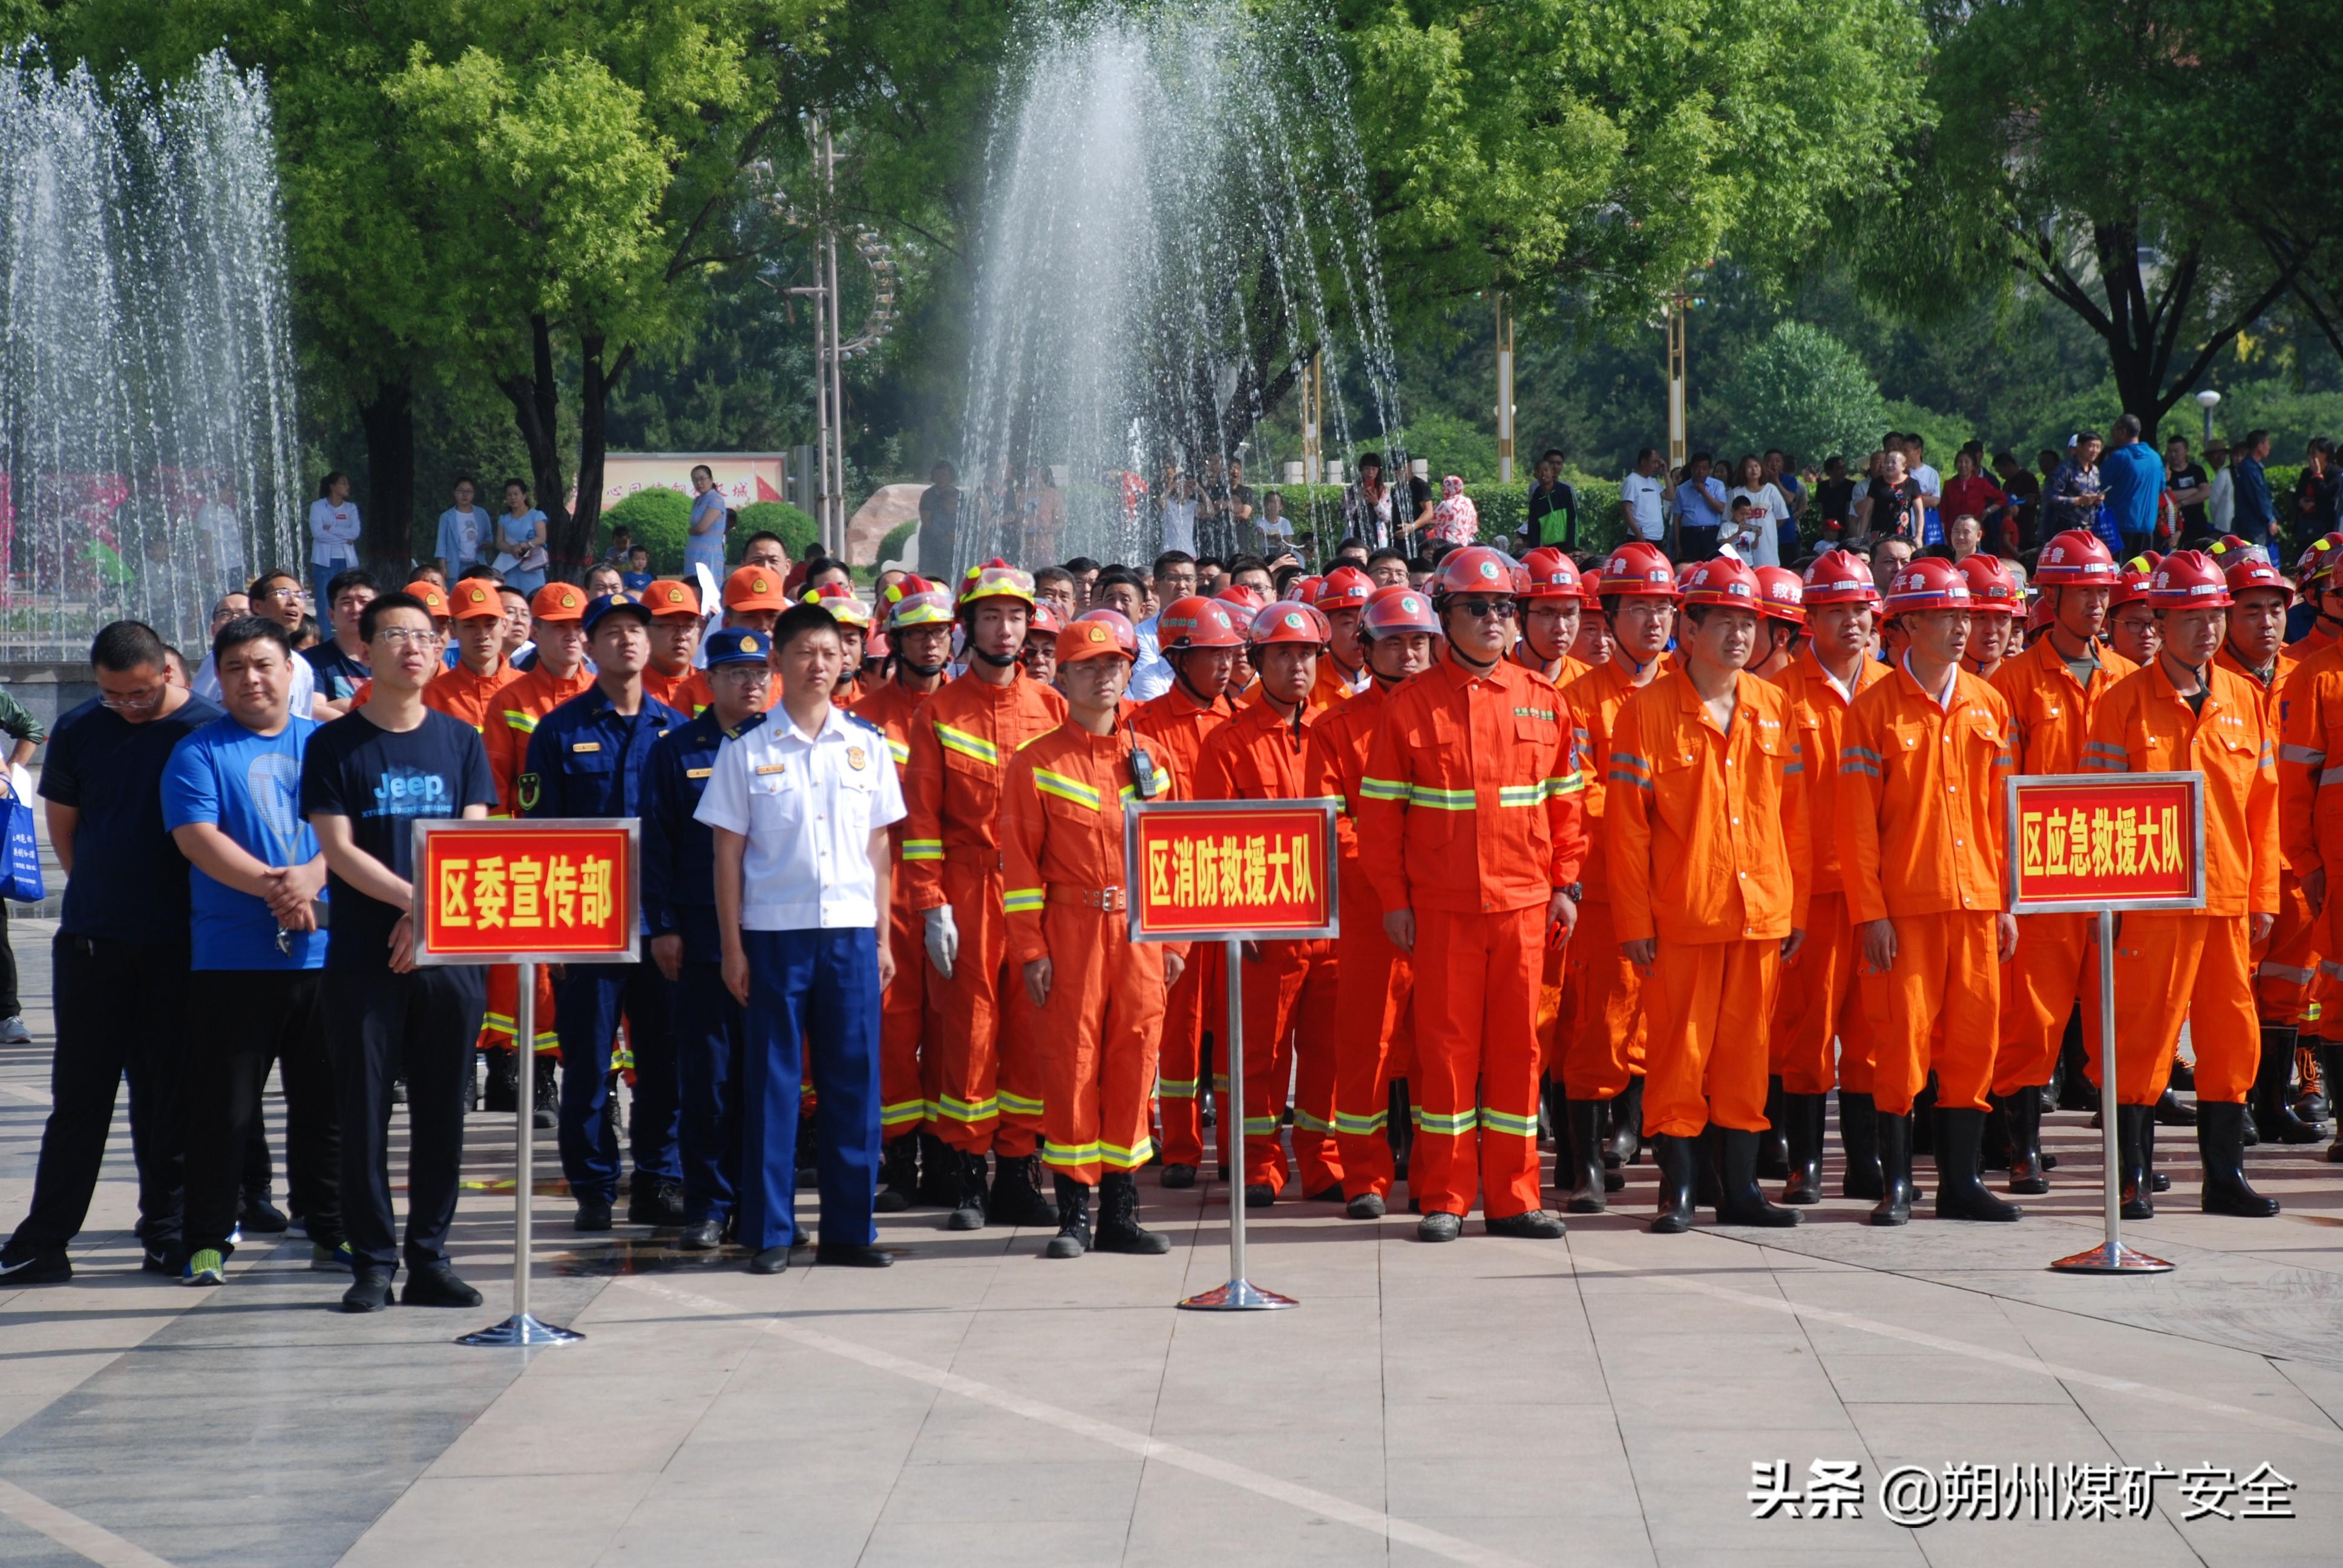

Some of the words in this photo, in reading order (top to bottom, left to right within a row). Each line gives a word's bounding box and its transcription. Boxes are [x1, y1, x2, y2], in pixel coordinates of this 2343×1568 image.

[373, 773, 444, 802] Jeep
[1149, 833, 1316, 907] 区消防救援大队
[2023, 805, 2183, 877] 区应急救援大队
[441, 854, 613, 930] 区委宣传部
